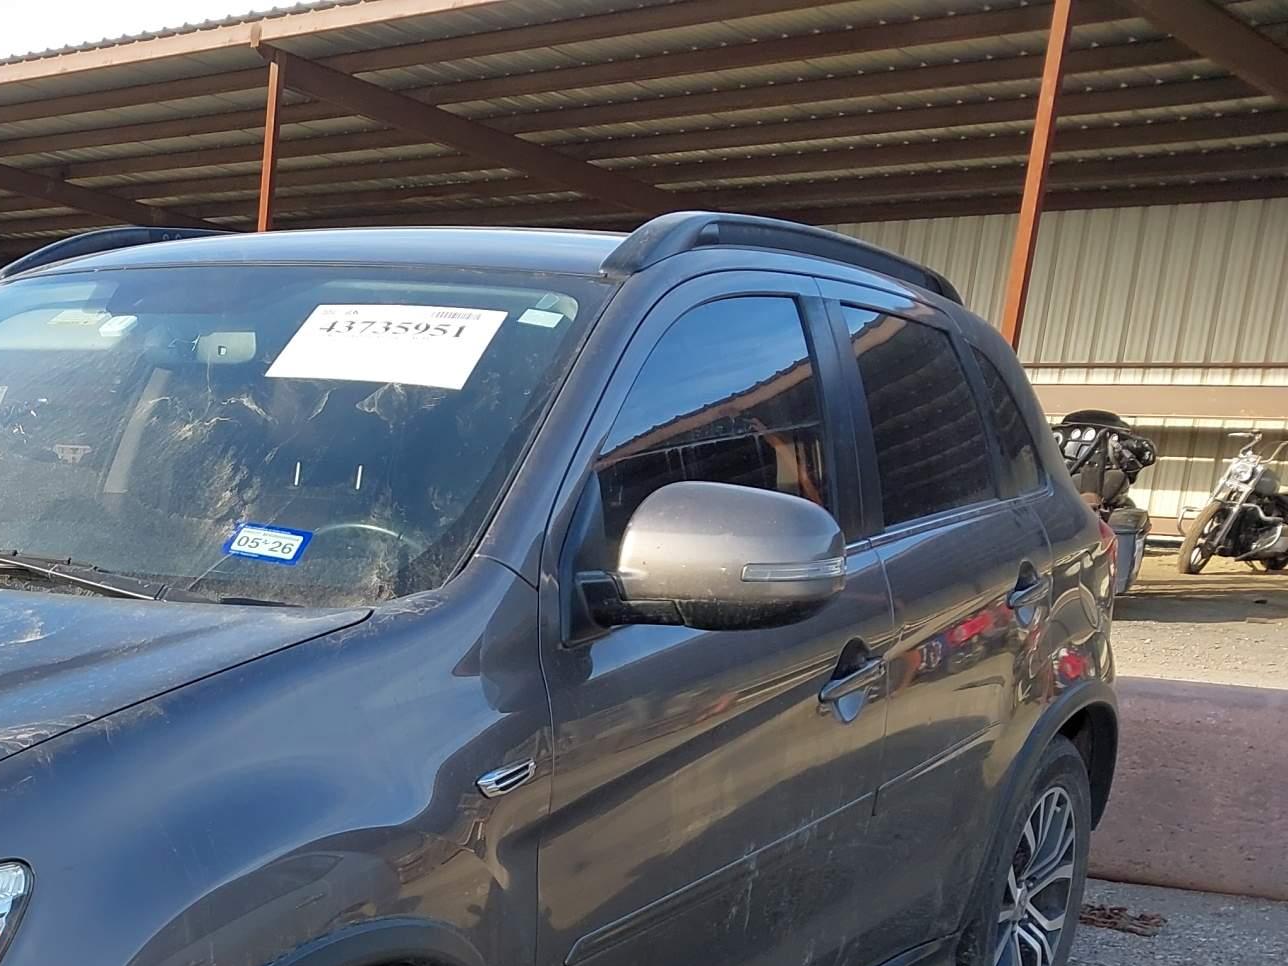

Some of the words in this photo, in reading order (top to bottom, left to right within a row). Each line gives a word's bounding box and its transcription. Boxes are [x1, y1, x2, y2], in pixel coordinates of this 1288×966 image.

[319, 320, 467, 338] 43735951
[237, 535, 262, 549] 05
[268, 540, 295, 555] 26
